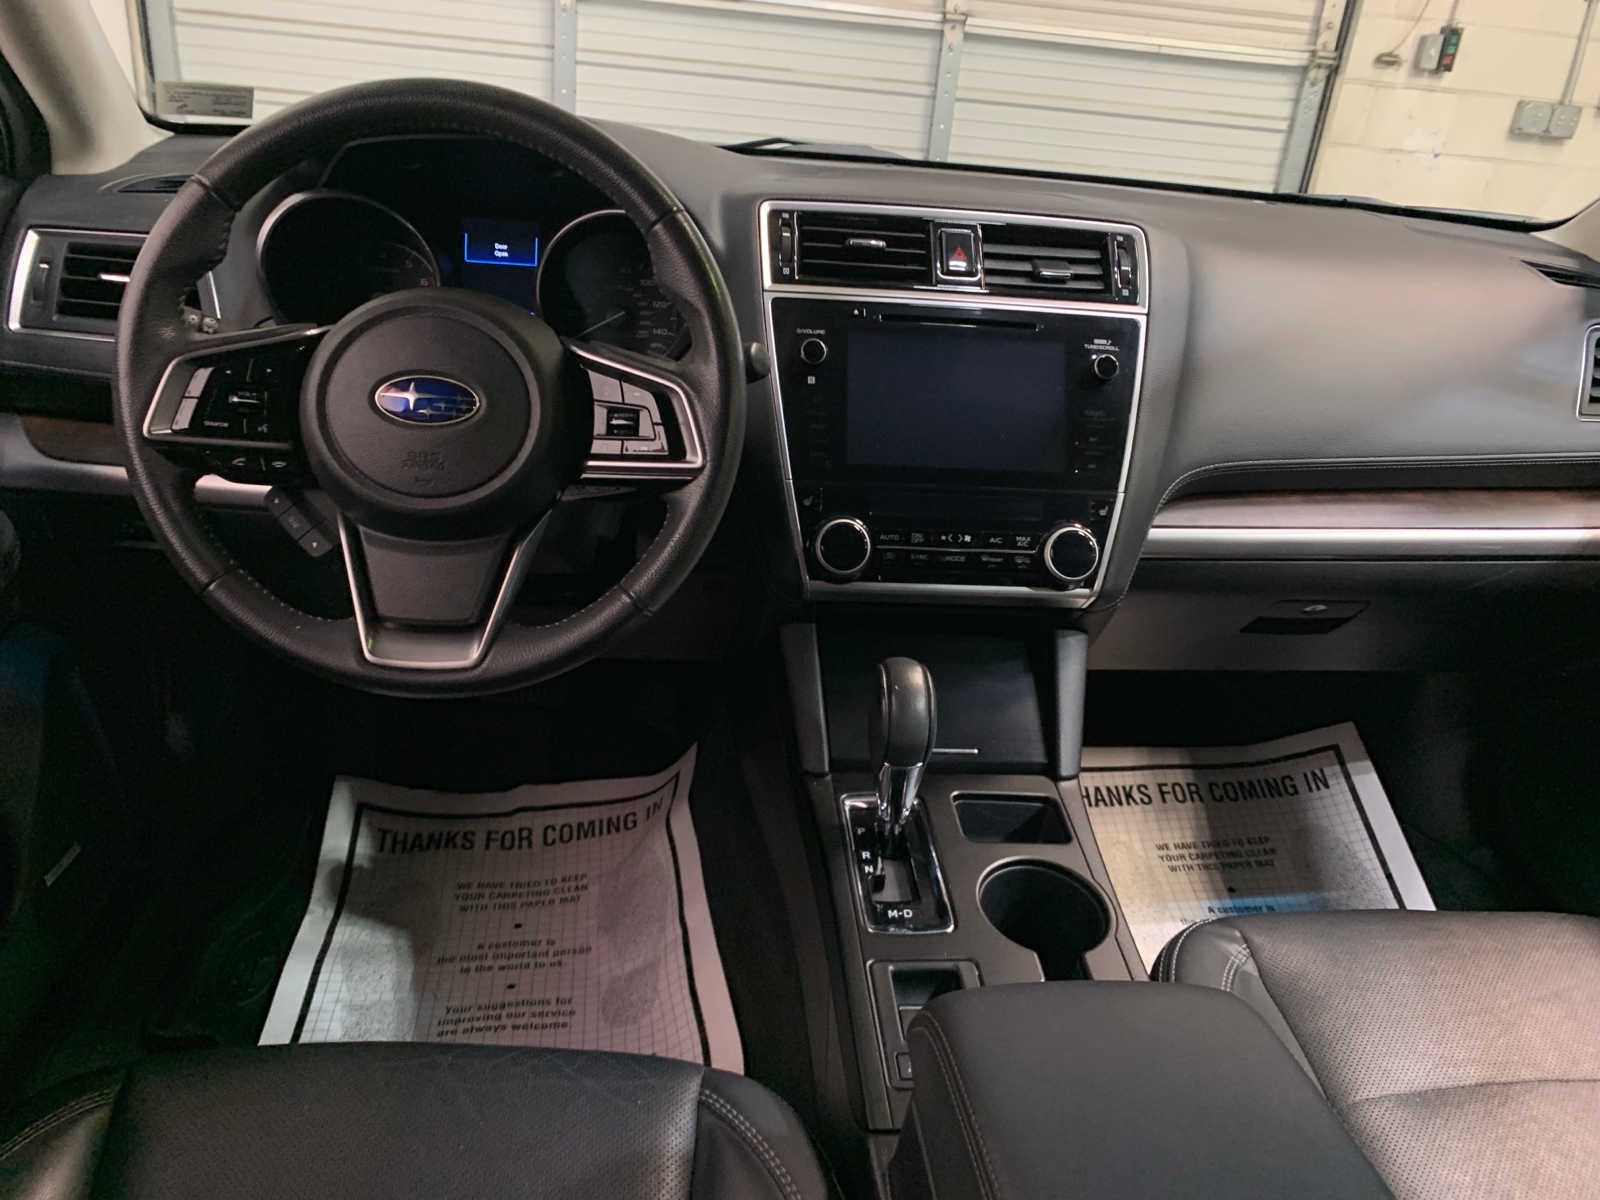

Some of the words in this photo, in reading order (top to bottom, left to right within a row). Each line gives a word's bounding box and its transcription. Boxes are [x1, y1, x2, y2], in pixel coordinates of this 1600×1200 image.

[1081, 784, 1153, 808] HANKS
[1157, 781, 1205, 804] FOR
[1208, 774, 1300, 803] COMING
[1303, 768, 1331, 793] IN
[376, 827, 476, 855] THANKS
[484, 826, 533, 852] FOR
[542, 811, 639, 848] COMING
[645, 800, 663, 821] IN
[856, 827, 866, 835] P
[1155, 842, 1170, 851] WE
[1173, 841, 1198, 850] HAVE
[861, 851, 872, 860] R
[1158, 853, 1187, 863] YOUR
[1189, 850, 1242, 861] CARPETING
[864, 865, 874, 874] N
[1168, 863, 1195, 873] WITH
[456, 880, 473, 890] WE
[477, 879, 506, 889] HAVE
[509, 879, 542, 889] TRIED
[544, 877, 558, 886] TO
[560, 872, 588, 883] KEEP
[454, 891, 485, 901] YOUR
[488, 889, 552, 900] CARPETING
[552, 884, 589, 895] CLEAN
[459, 903, 489, 912] WITH
[492, 901, 517, 911] THIS
[520, 899, 556, 909] PAPER
[1207, 906, 1216, 915] A
[1217, 904, 1263, 913] customer
[1265, 904, 1277, 912] is
[488, 939, 543, 949] customer
[546, 938, 557, 947] is
[437, 953, 456, 965] the
[459, 952, 489, 962] most
[492, 949, 550, 961] important
[552, 945, 592, 957] person
[475, 964, 494, 973] the
[497, 961, 531, 971] world
[534, 960, 546, 968] to
[476, 998, 552, 1012] suggestions
[555, 997, 573, 1005] for
[437, 1014, 503, 1026] improving
[506, 1011, 526, 1019] our
[530, 1008, 576, 1018] service
[436, 1029, 458, 1037] are
[462, 1023, 507, 1035] always
